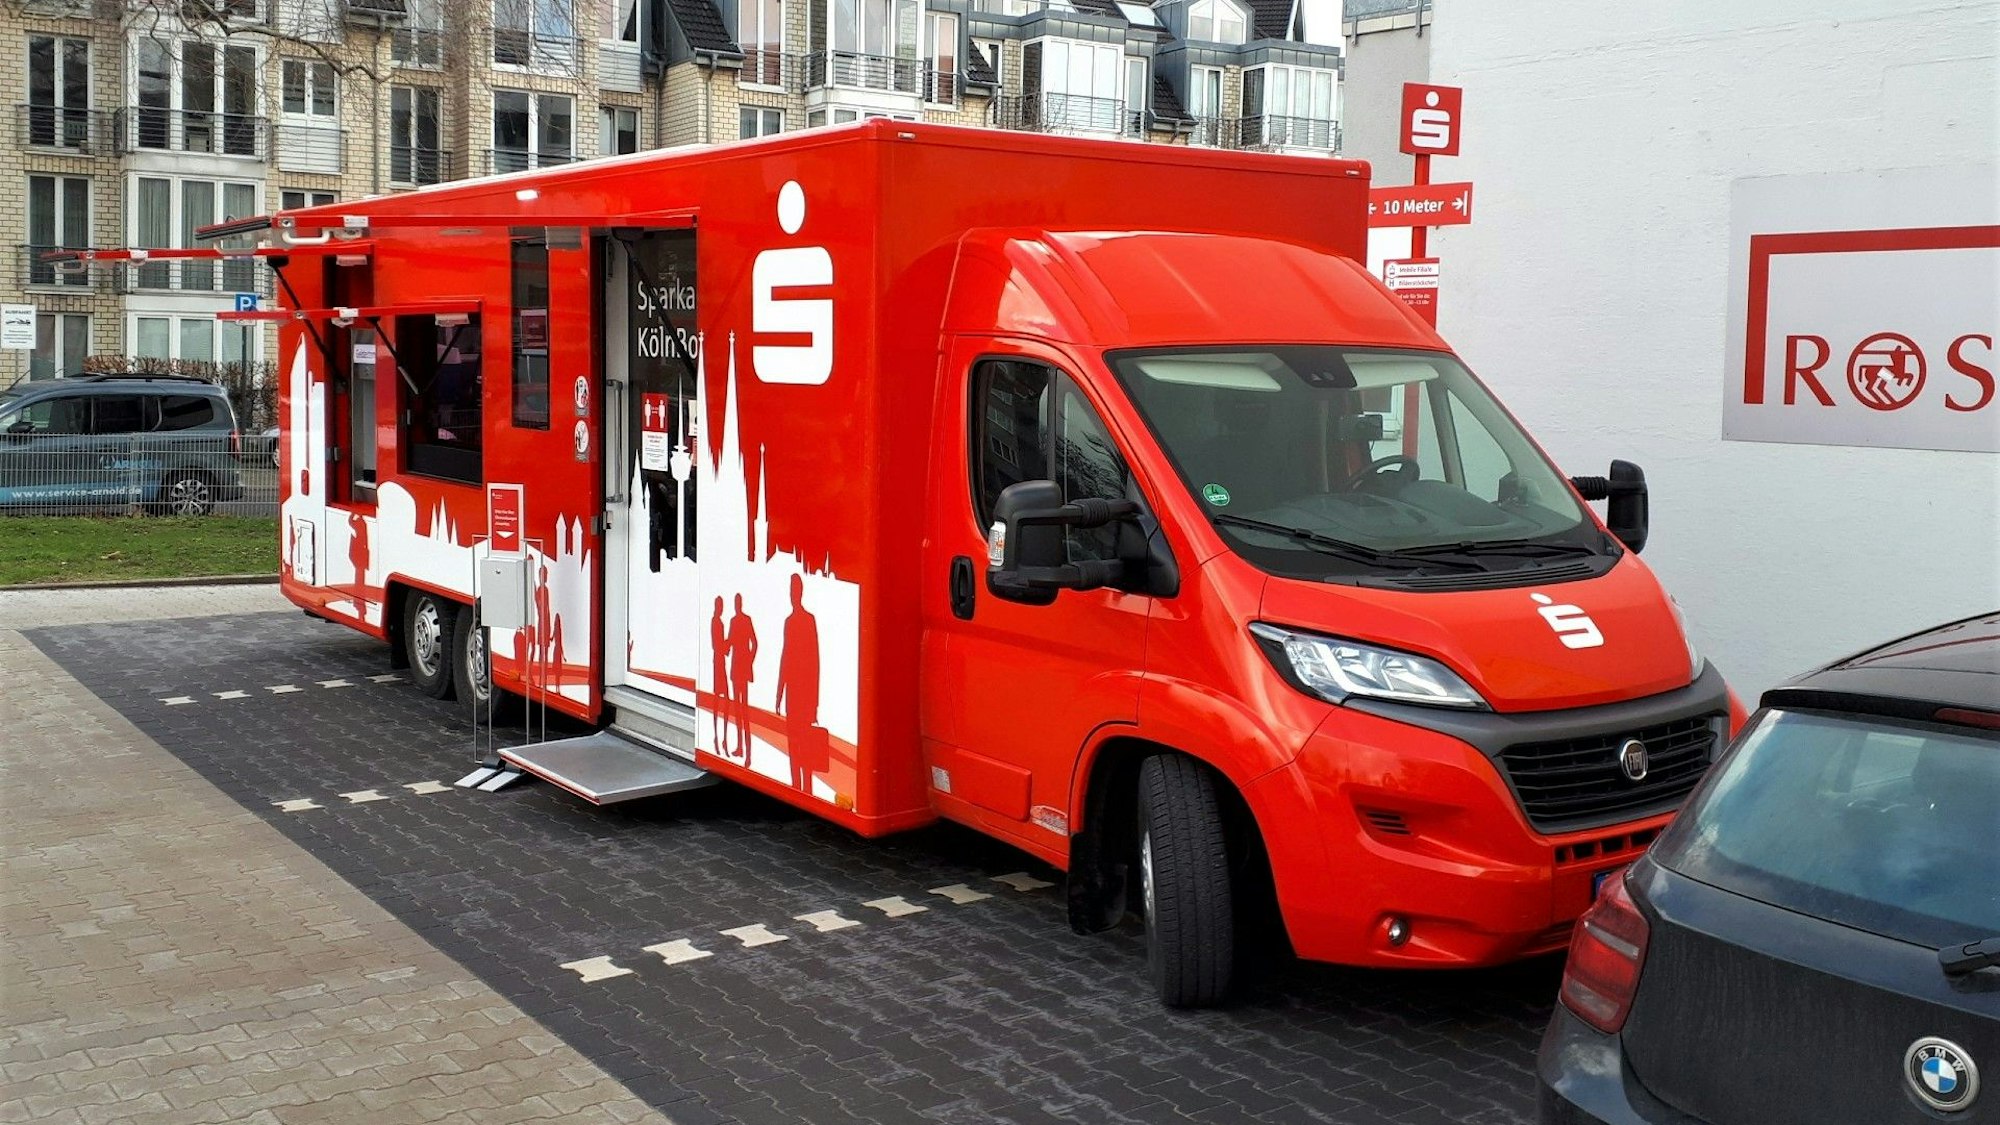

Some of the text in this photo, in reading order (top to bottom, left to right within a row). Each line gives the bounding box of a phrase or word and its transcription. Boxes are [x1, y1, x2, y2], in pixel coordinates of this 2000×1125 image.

[1383, 200, 1444, 215] 10 Meter
[11, 486, 144, 499] www.service-arnold.de
[1918, 1048, 1966, 1072] BMW
